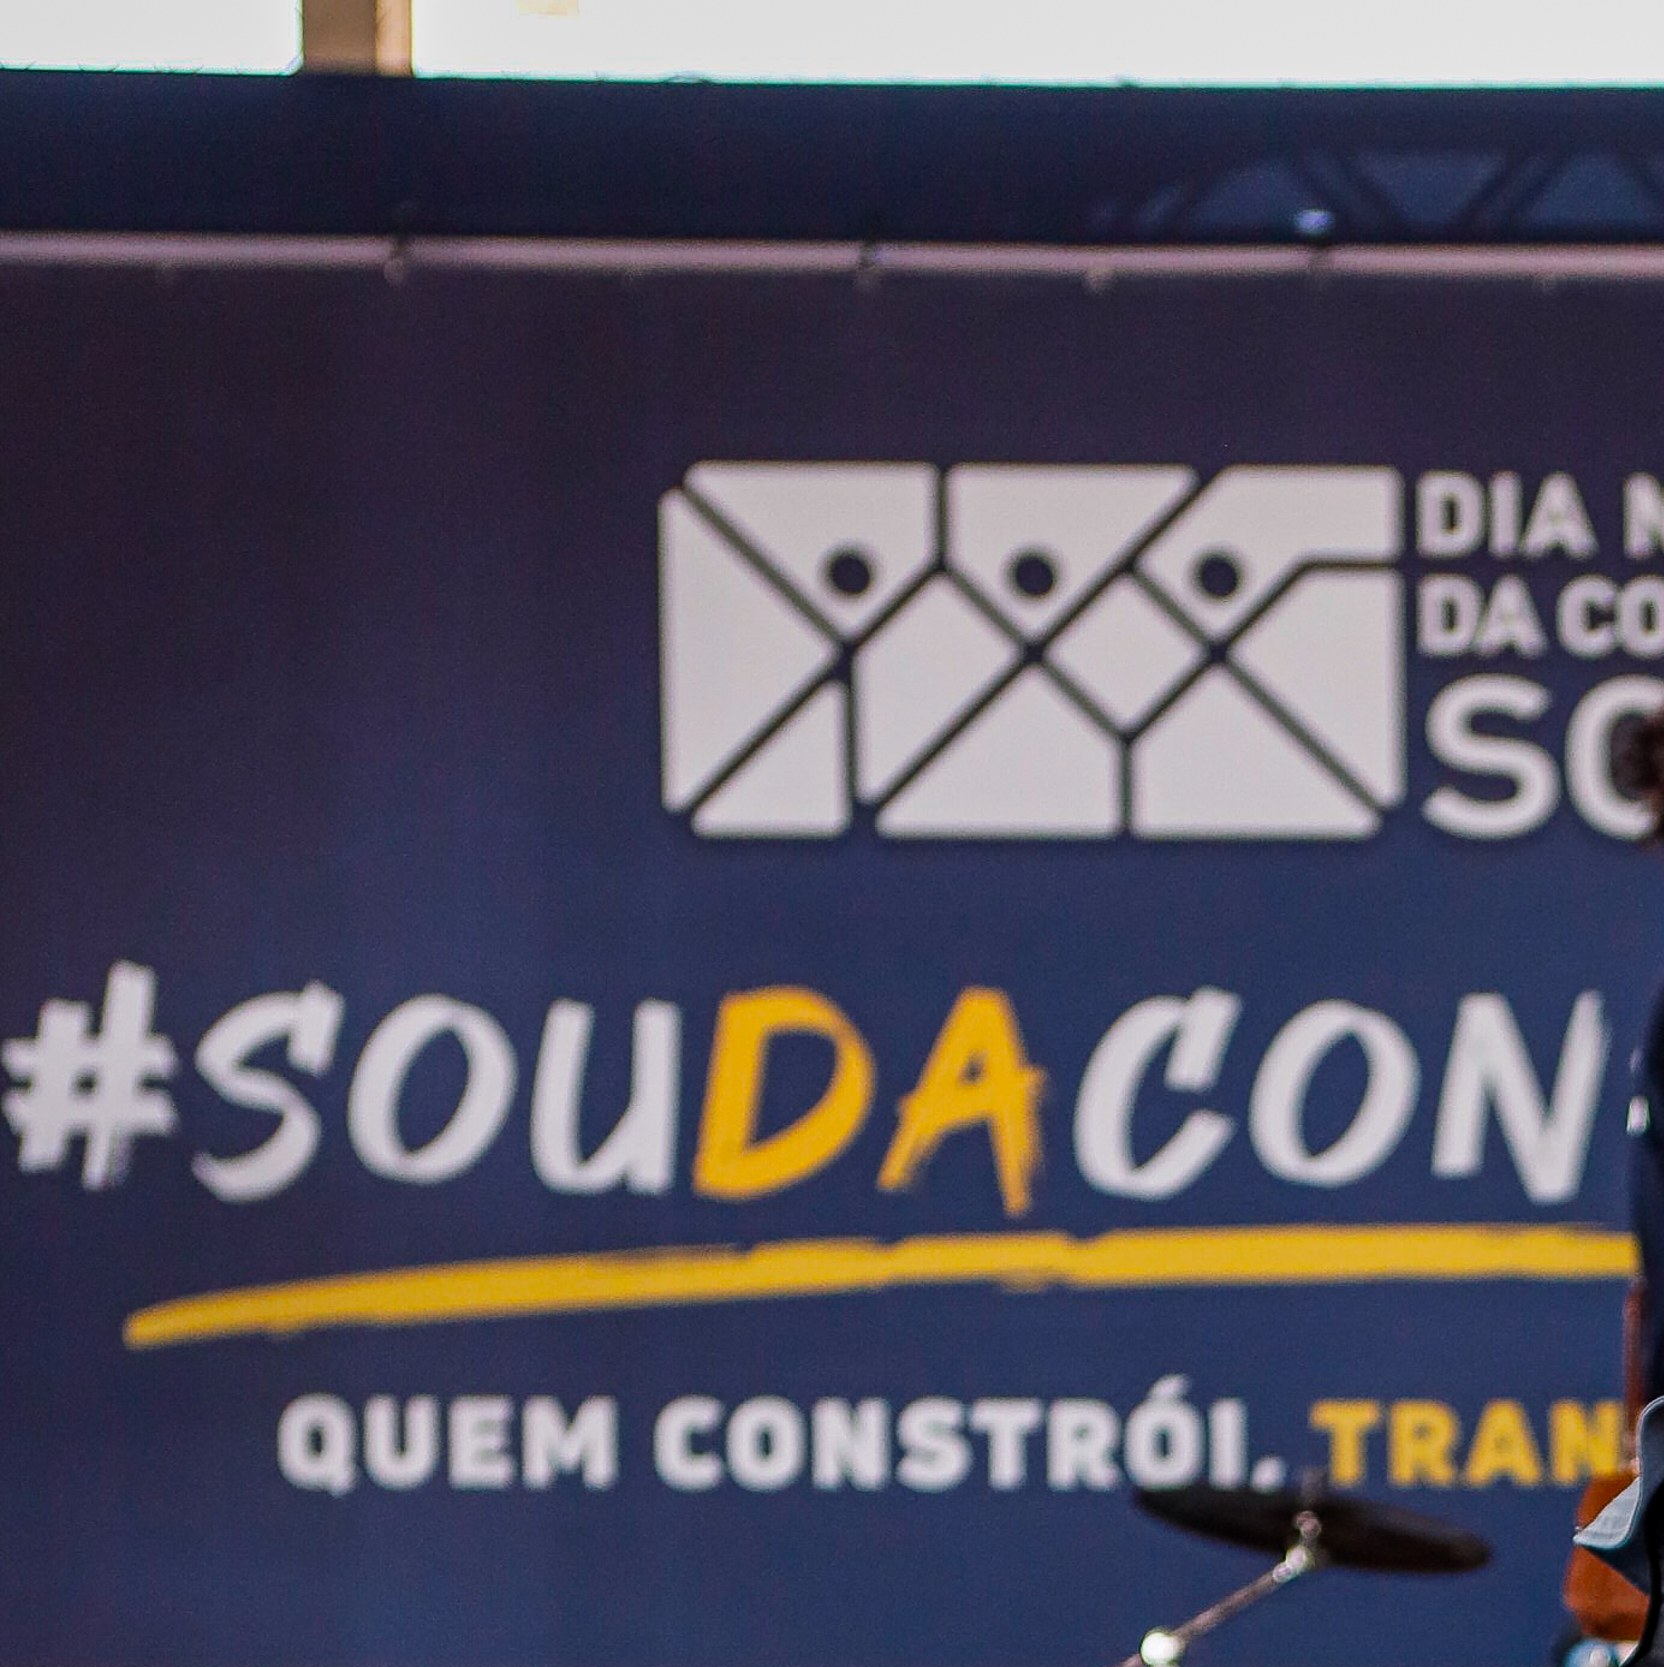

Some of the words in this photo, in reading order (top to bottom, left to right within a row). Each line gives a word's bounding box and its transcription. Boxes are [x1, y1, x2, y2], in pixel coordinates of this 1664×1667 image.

[1414, 470, 1598, 561] DIA
[1415, 573, 1549, 659] DA
[275, 1393, 620, 1497] QUEM
